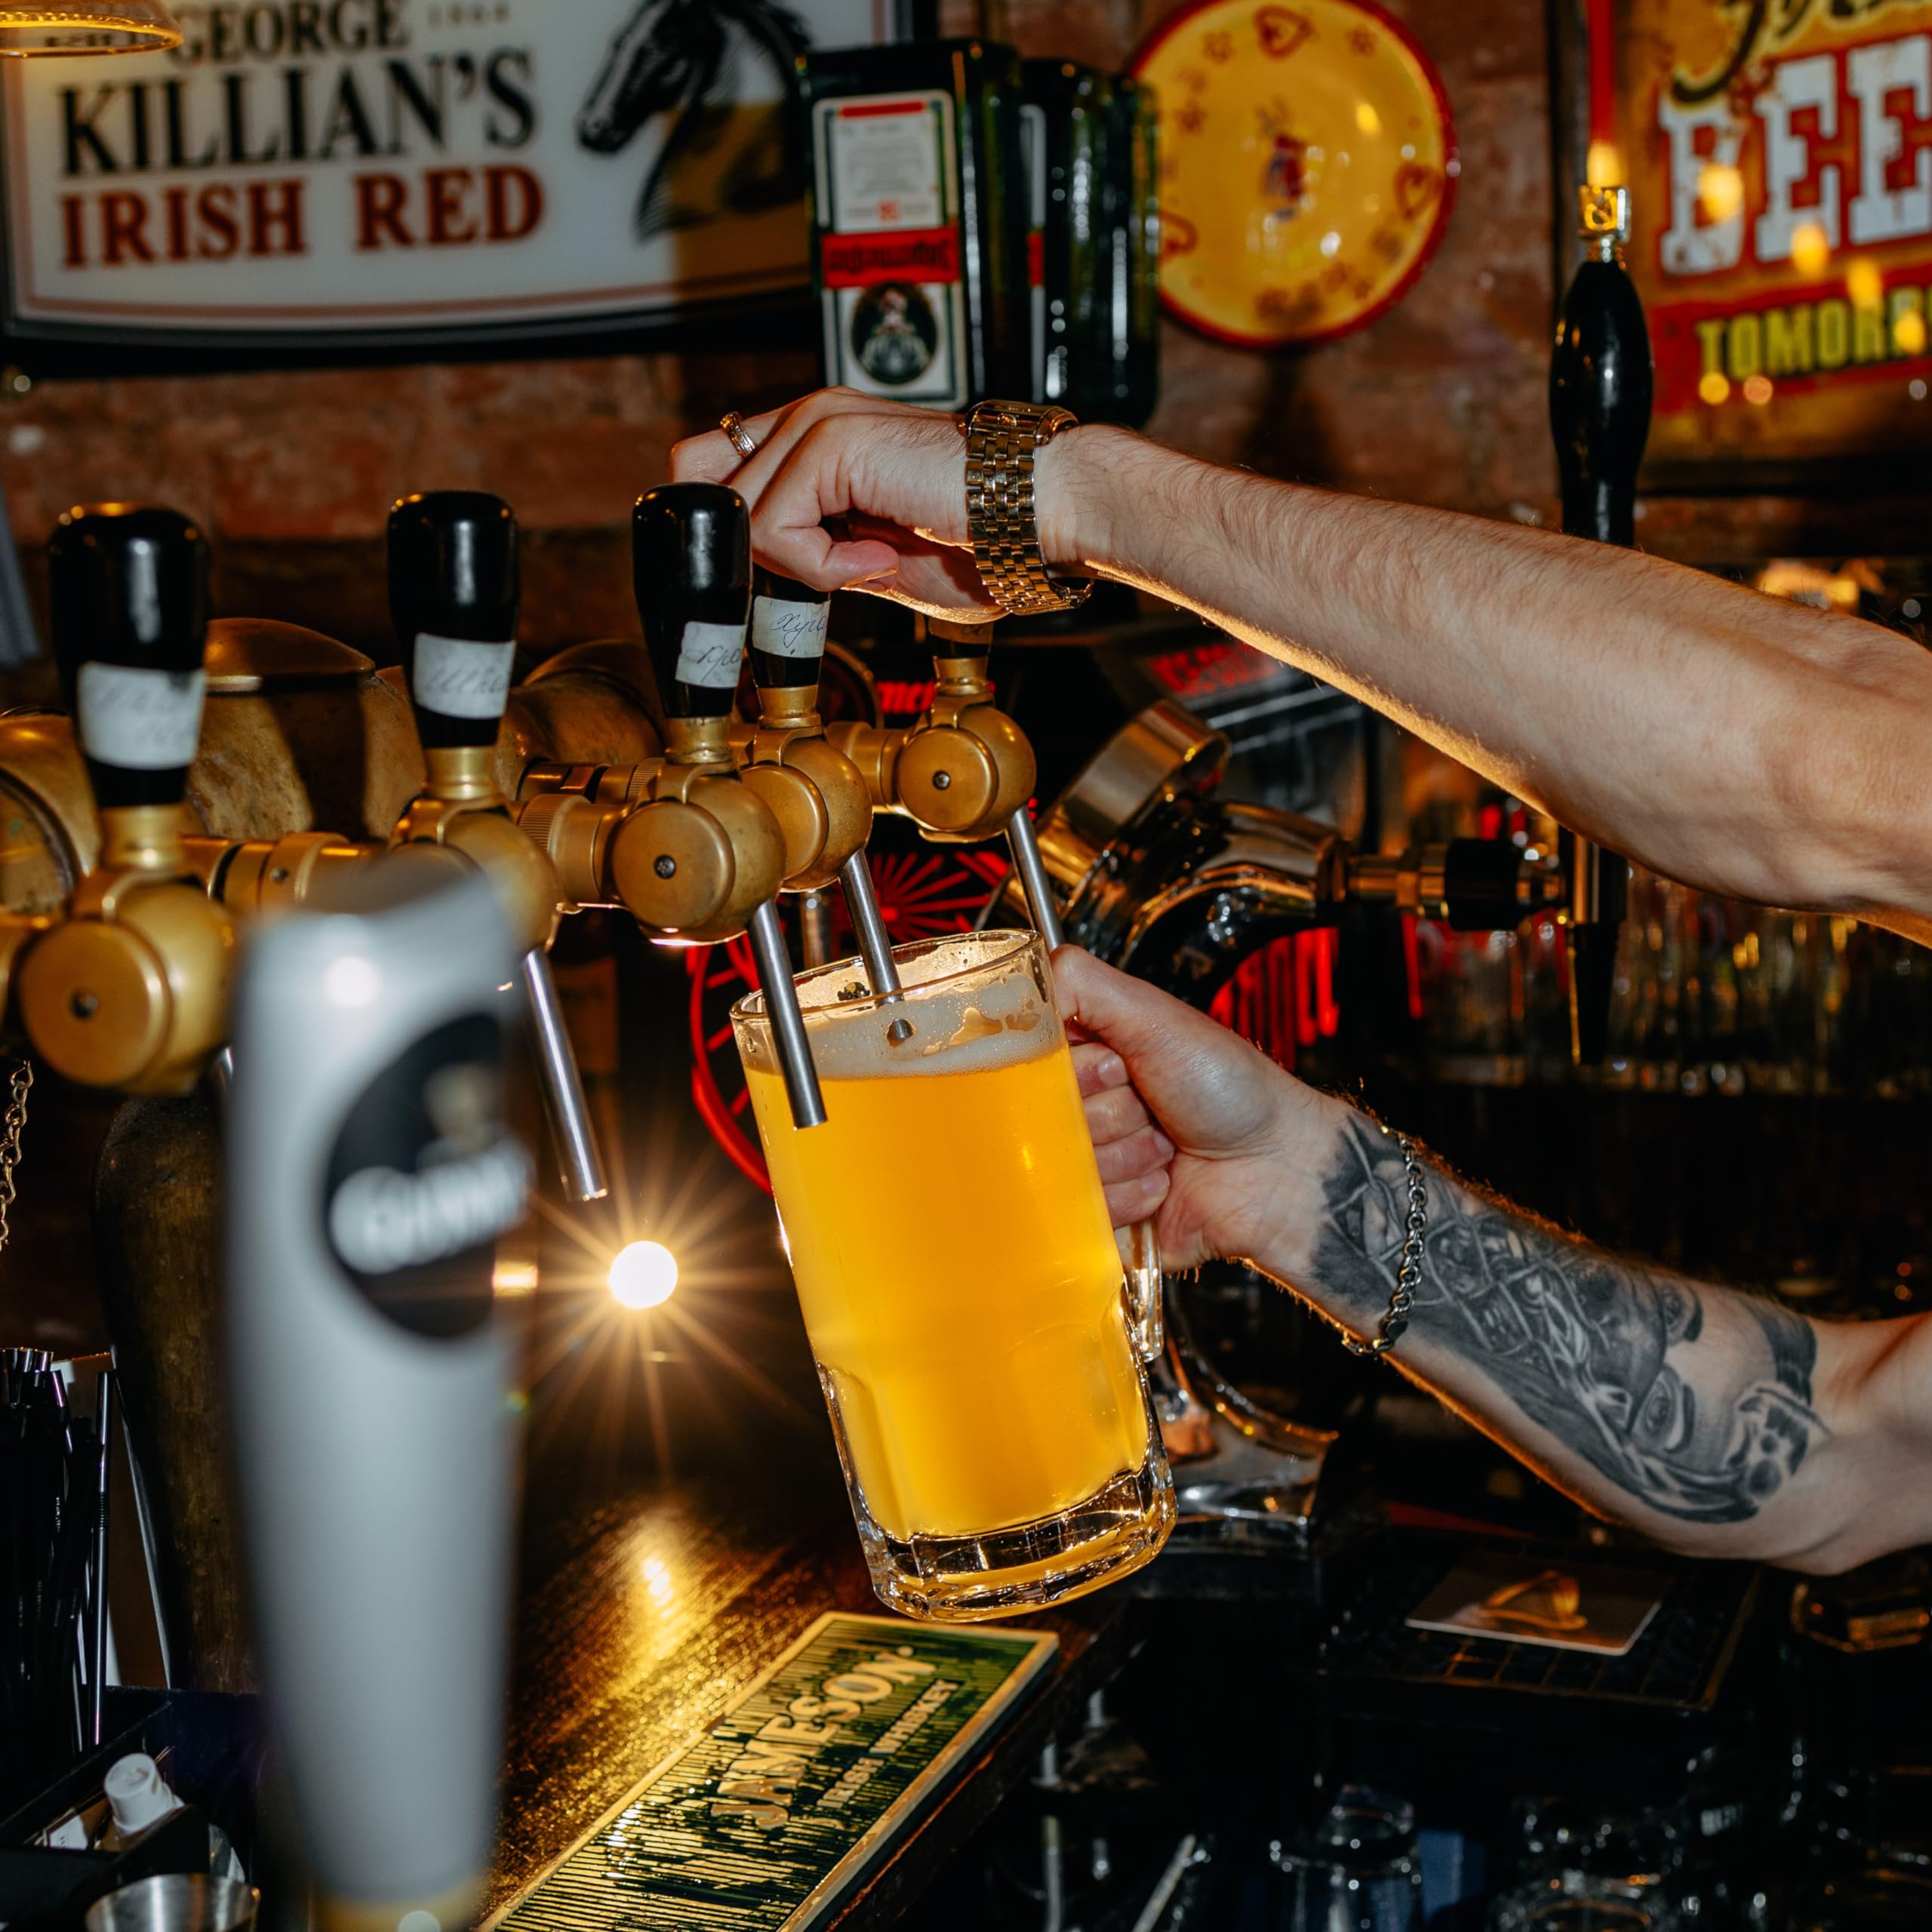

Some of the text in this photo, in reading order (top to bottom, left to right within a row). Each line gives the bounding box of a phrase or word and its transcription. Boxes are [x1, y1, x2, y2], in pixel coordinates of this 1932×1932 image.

[165, 0, 412, 67] GEORGE
[58, 46, 537, 177] KILLIAN'S
[60, 164, 546, 271] IRISH RED
[1694, 285, 1932, 381] TOMOR
[817, 1679, 960, 1809] IRISH WHISKEY
